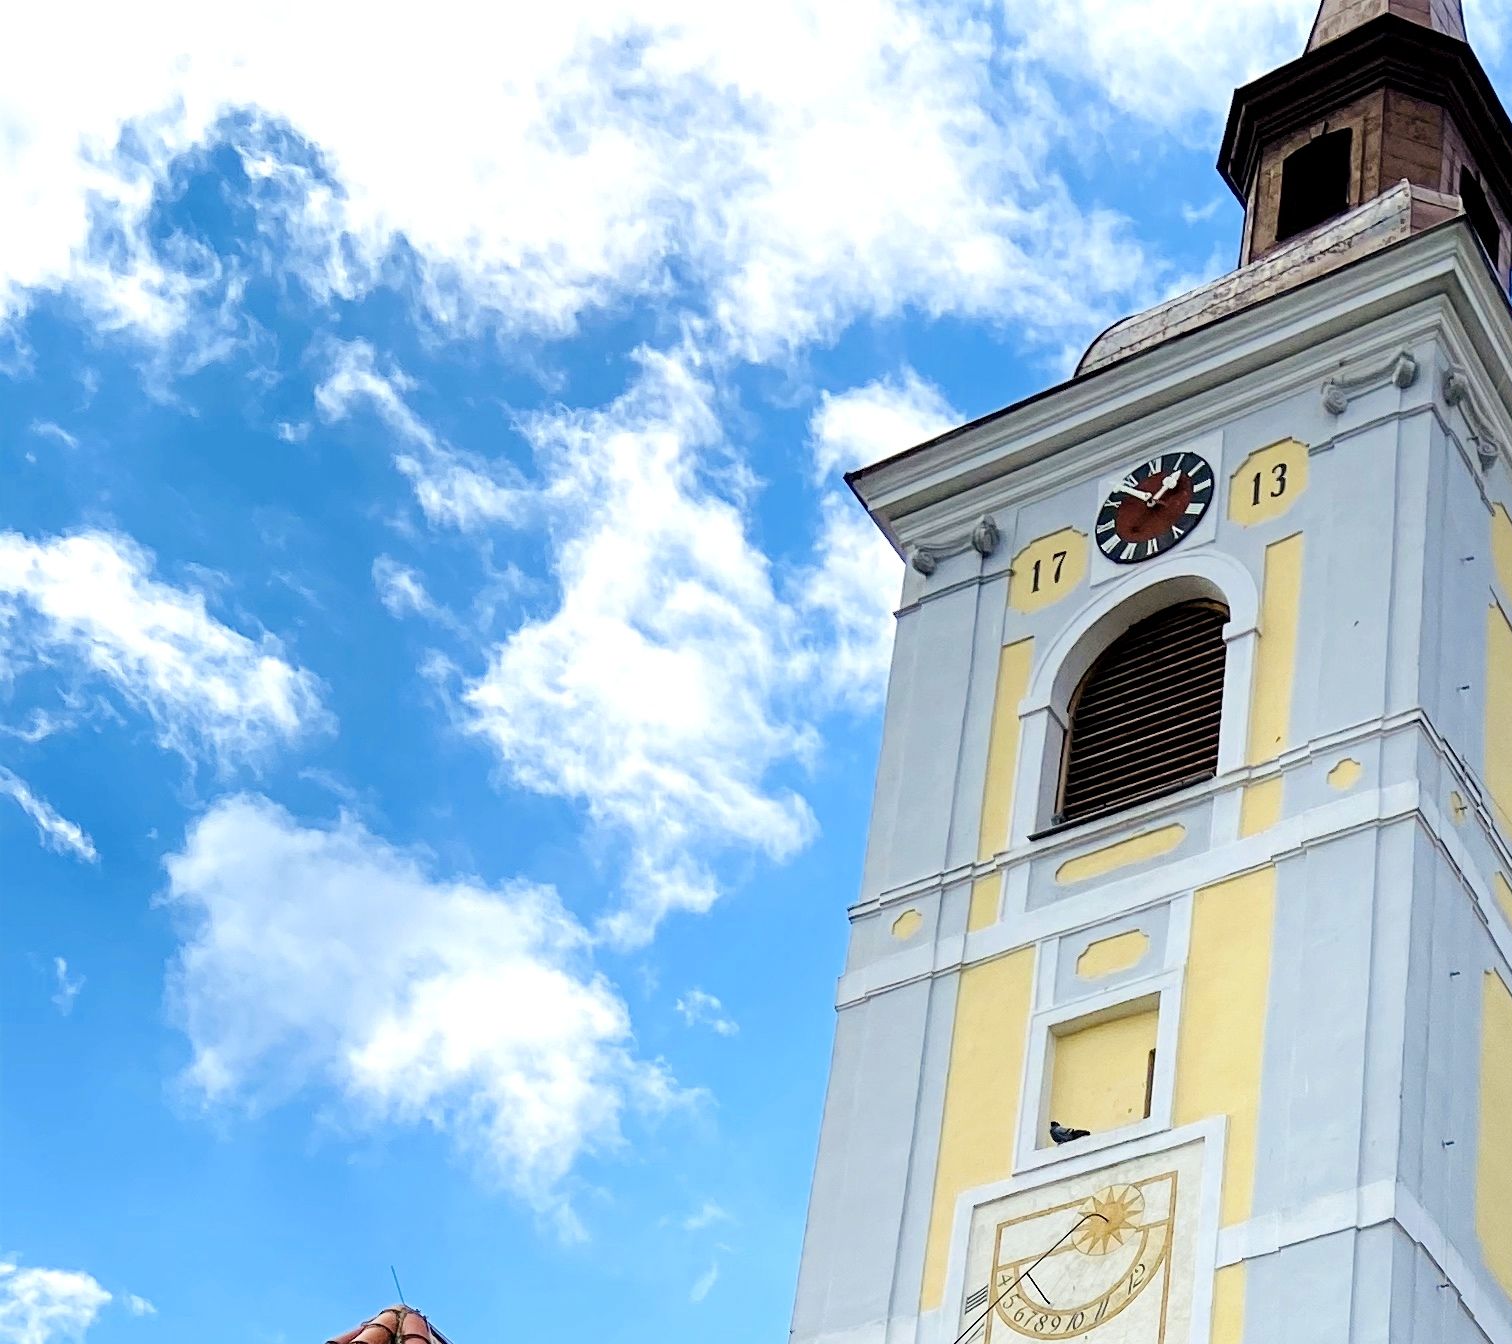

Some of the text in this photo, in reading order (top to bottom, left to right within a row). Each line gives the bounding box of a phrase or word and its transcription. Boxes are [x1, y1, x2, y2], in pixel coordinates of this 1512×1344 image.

[1031, 463, 1287, 593] 17 13
[998, 1273, 1013, 1288] 4
[1126, 1263, 1146, 1295] 12
[1002, 1293, 1022, 1310] 5
[1013, 1308, 1025, 1322] 6
[1023, 1311, 1037, 1328] 7
[1034, 1314, 1049, 1333] 8
[1066, 1311, 1085, 1332] 10
[1049, 1315, 1062, 1335] 9
